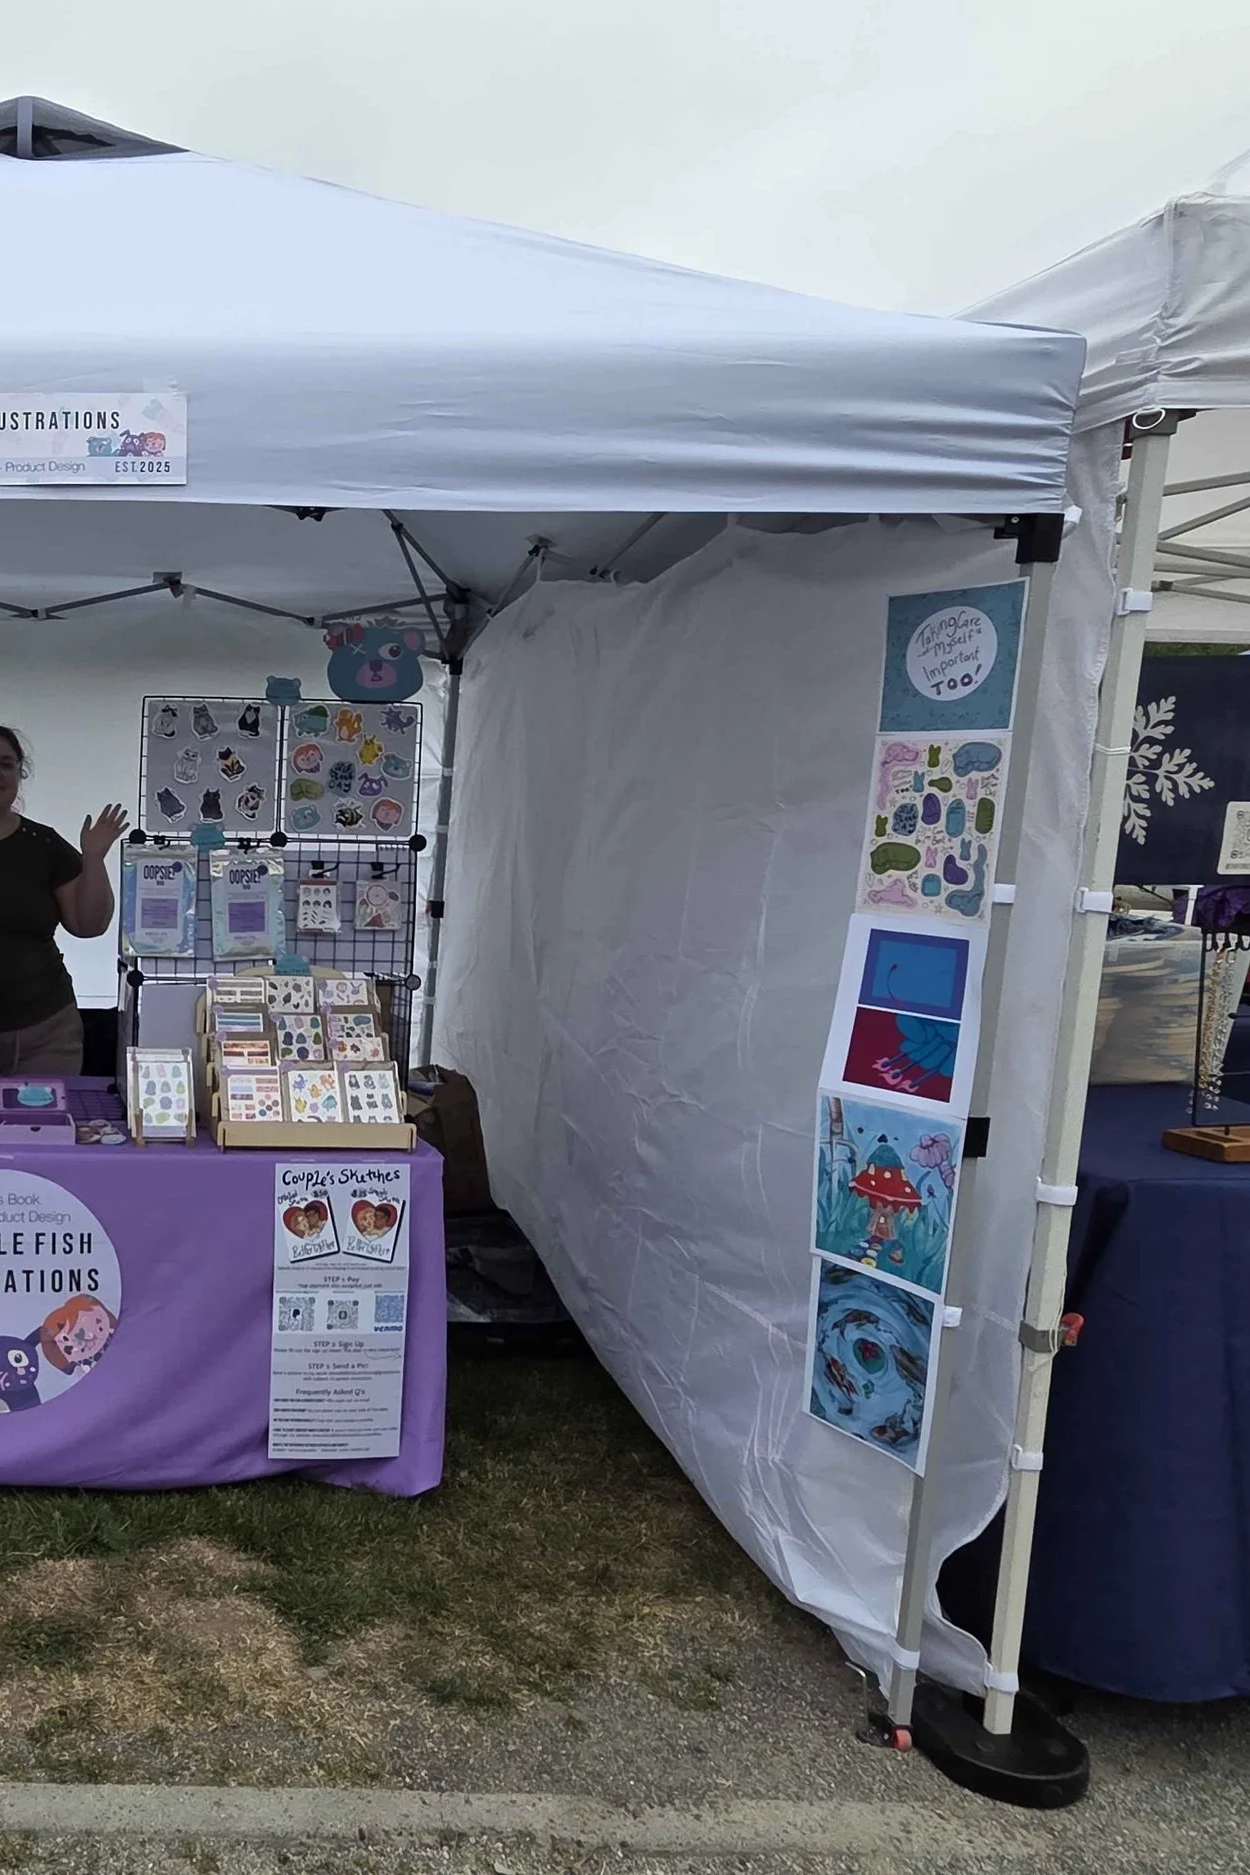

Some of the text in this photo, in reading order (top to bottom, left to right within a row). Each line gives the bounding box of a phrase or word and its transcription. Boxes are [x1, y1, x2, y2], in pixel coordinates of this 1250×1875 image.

[5, 460, 47, 474] Product
[48, 460, 86, 475] Design
[922, 645, 980, 682] Important
[930, 663, 983, 696] TOO!
[282, 1168, 401, 1190] Couple's Sketches
[7, 1193, 40, 1206] Book
[28, 1210, 72, 1225] Design
[34, 1231, 93, 1255] FISH
[347, 1276, 360, 1285] Pay
[374, 1325, 403, 1333] venmo
[338, 1341, 353, 1350] Sign
[355, 1341, 365, 1349] Up
[296, 1388, 331, 1397] Frequently
[333, 1388, 353, 1396] Asked
